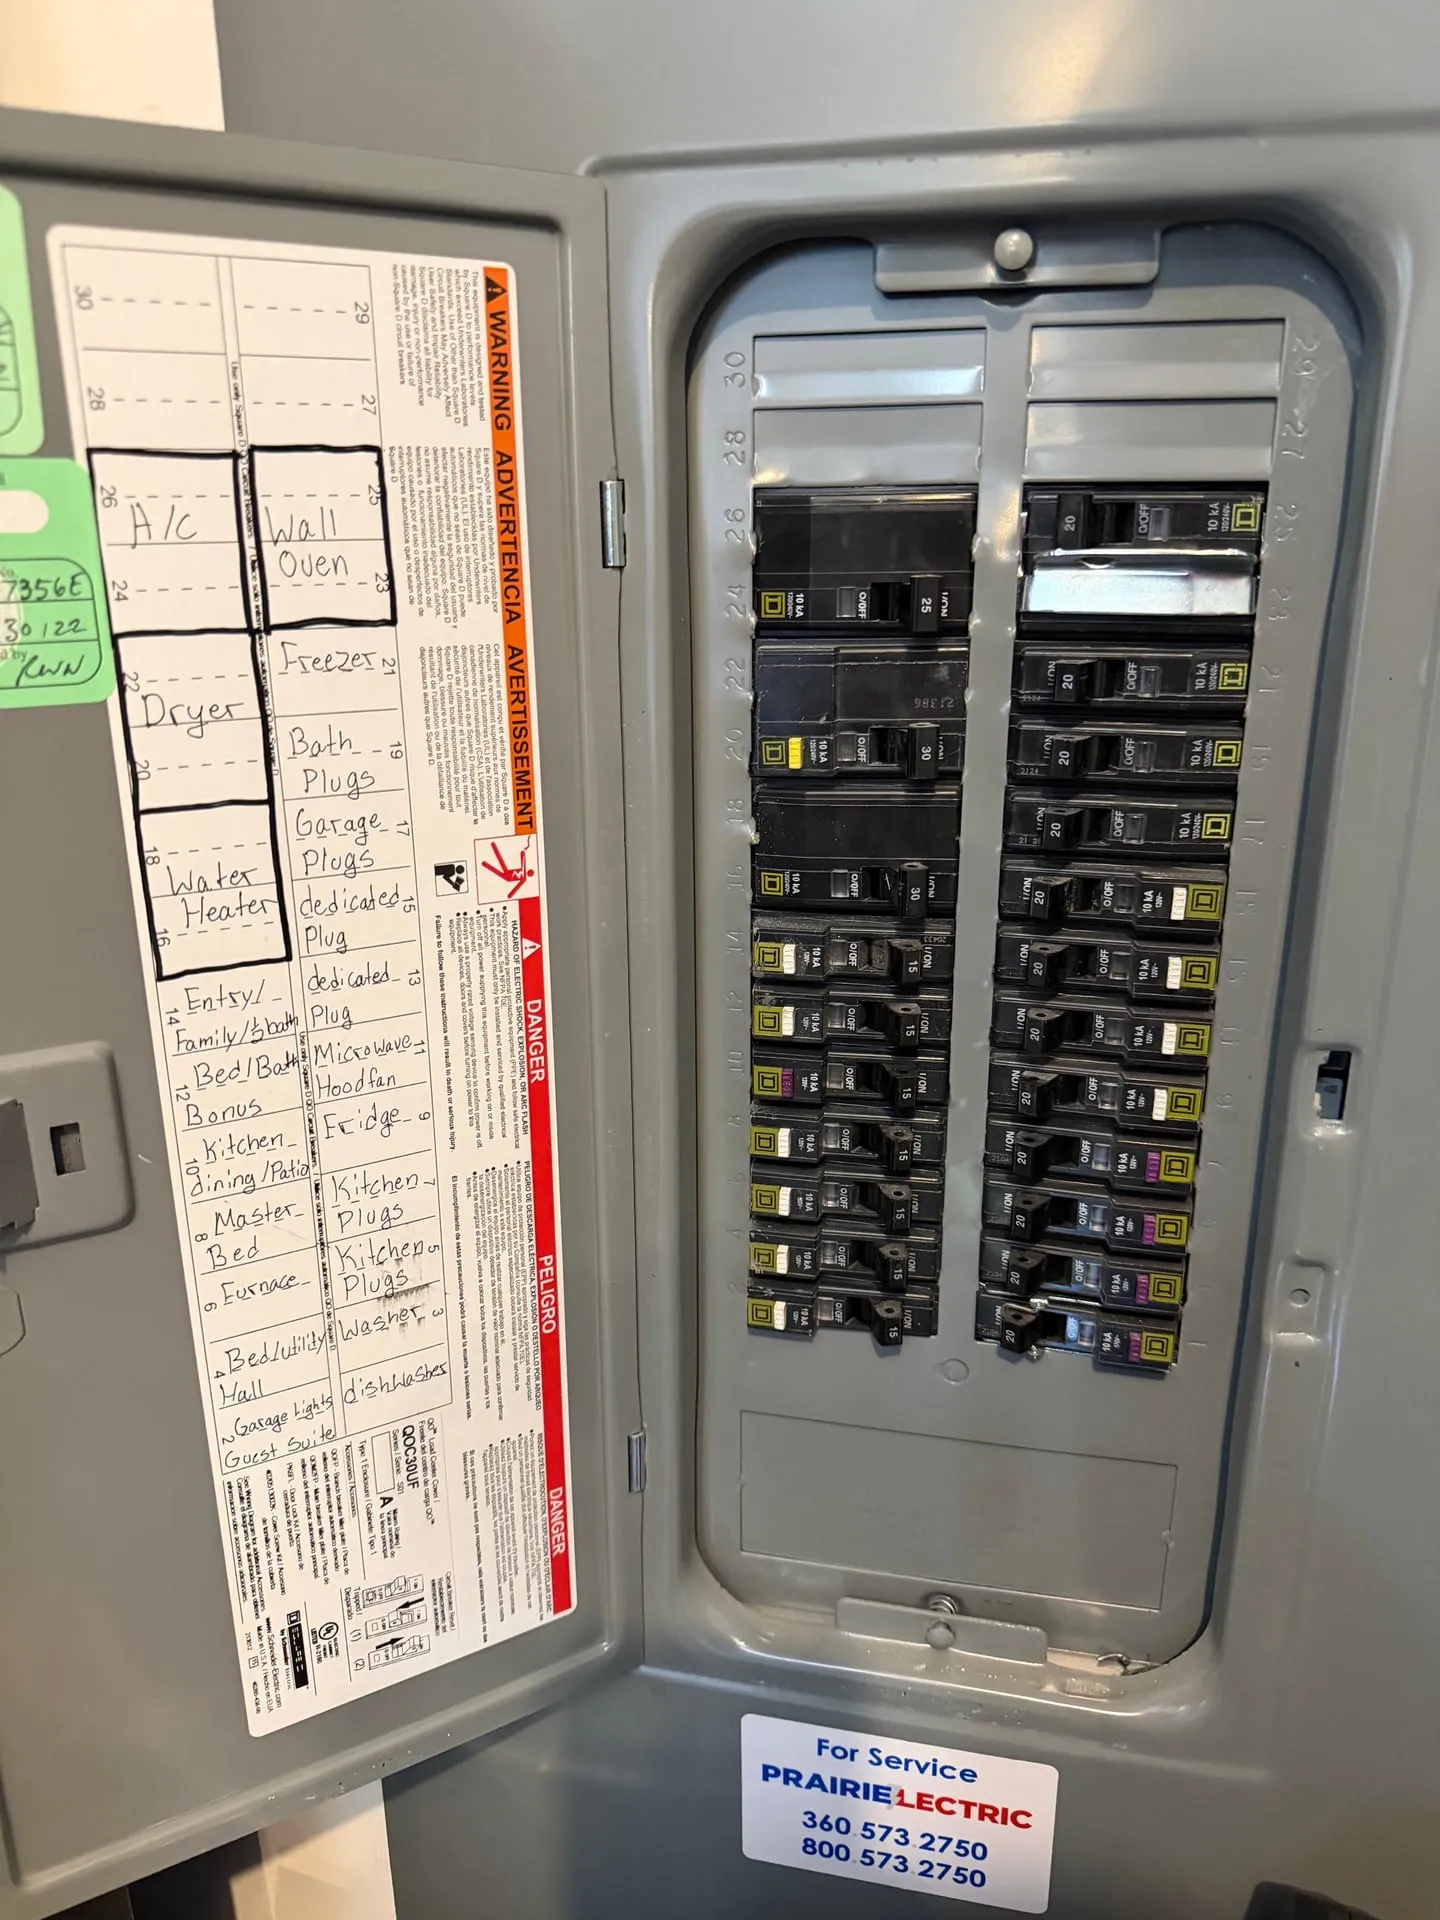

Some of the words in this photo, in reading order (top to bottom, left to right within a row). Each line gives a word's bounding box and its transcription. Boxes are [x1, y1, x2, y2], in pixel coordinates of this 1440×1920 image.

[74, 286, 93, 310] 30
[354, 302, 371, 324] 29
[489, 310, 511, 431] WARNING
[724, 351, 746, 388] 30
[87, 387, 106, 411] 28
[361, 394, 377, 415] 27
[723, 430, 745, 466] 28
[100, 485, 118, 509] 26
[368, 484, 381, 506] 25
[1209, 502, 1220, 516] kA
[725, 508, 745, 543] 26
[1064, 515, 1076, 532] 20
[1208, 518, 1218, 532] 10
[496, 450, 521, 624] ADVERTENCIA
[111, 580, 129, 602] 24
[726, 584, 747, 620] 24
[921, 597, 931, 613] 25
[381, 658, 397, 675] 21
[725, 657, 746, 691] 22
[122, 671, 140, 693] 22
[1062, 674, 1074, 689] 20
[507, 645, 533, 828] AVERTISSEMENT
[725, 728, 743, 762] 20
[389, 741, 403, 759] 19
[921, 745, 932, 761] 30
[1059, 750, 1070, 766] 20
[134, 759, 150, 780] 20
[725, 799, 744, 826] 18
[396, 820, 410, 837] 17
[1050, 822, 1061, 837] 20
[144, 846, 160, 866] 18
[911, 887, 921, 901] 30
[1034, 890, 1045, 905] 20
[402, 895, 416, 913] 15
[511, 920, 519, 952] HAZARD
[908, 960, 918, 973] 15
[1033, 961, 1043, 976] 20
[408, 969, 421, 986] 13
[513, 966, 522, 1004] ELECTRIC
[165, 1008, 180, 1025] 14
[515, 1005, 523, 1034] SHOCK,
[905, 1024, 915, 1036] 15
[1030, 1027, 1041, 1042] 20
[413, 1040, 425, 1055] 11
[527, 999, 545, 1083] DANGER
[517, 1036, 526, 1080] EXPLOSION,
[175, 1085, 190, 1102] 12
[902, 1087, 912, 1099] 15
[1021, 1091, 1031, 1106] 20
[418, 1111, 430, 1121] 9
[521, 1111, 529, 1135] FLASH
[899, 1150, 908, 1161] 15
[1017, 1151, 1027, 1165] 20
[185, 1158, 200, 1176] 10
[896, 1208, 905, 1220] 15
[1015, 1214, 1026, 1228] 20
[194, 1233, 209, 1242] 8
[428, 1245, 440, 1253] 5
[893, 1269, 903, 1280] 15
[1010, 1271, 1020, 1285] 20
[539, 1254, 556, 1334] PELIGRO
[203, 1302, 217, 1312] 6
[431, 1307, 444, 1317] 3
[889, 1326, 898, 1338] 15
[1005, 1329, 1016, 1344] 20
[213, 1370, 226, 1379] 4
[222, 1435, 236, 1445] 2
[402, 1425, 419, 1490] QOC30UF
[379, 1496, 394, 1509] A
[549, 1486, 564, 1557] DANGER
[817, 1738, 859, 1762] For
[869, 1747, 978, 1783] Service
[802, 1811, 988, 1861] 360.573.2750
[801, 1837, 986, 1889] 800.573.2750
